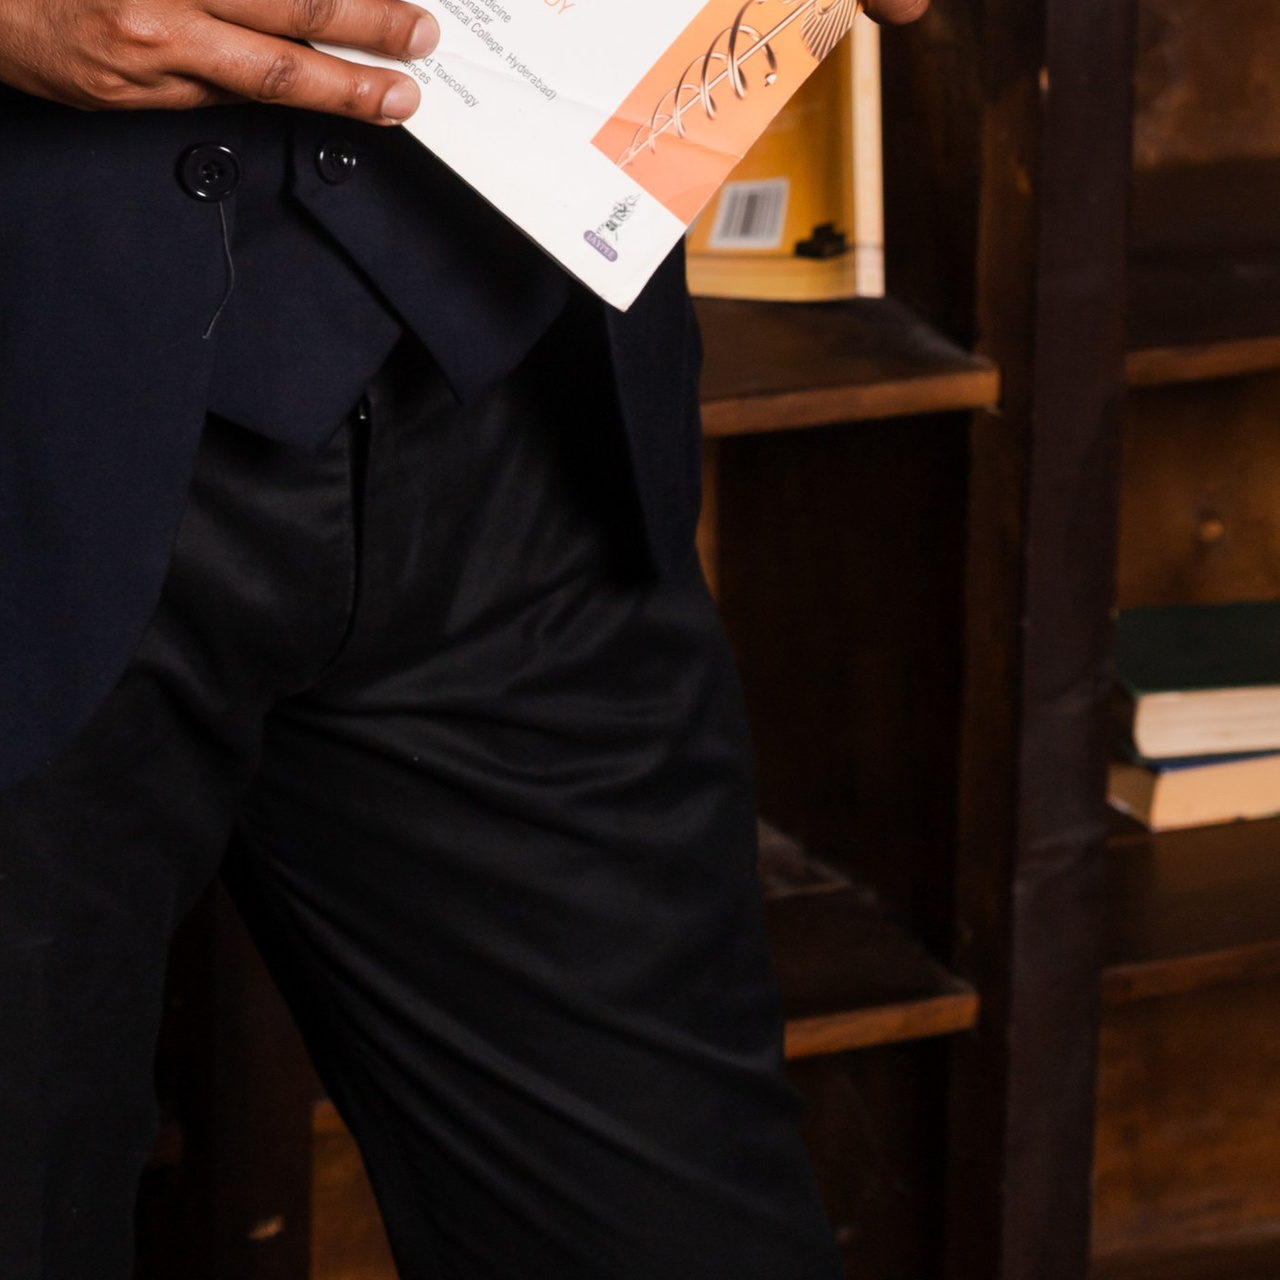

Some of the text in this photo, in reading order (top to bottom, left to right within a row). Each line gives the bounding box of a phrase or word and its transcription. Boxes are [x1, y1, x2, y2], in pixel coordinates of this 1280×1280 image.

[433, 62, 479, 107] Toxicology
[470, 22, 503, 57] College,
[505, 52, 556, 100] Hyderabad)
